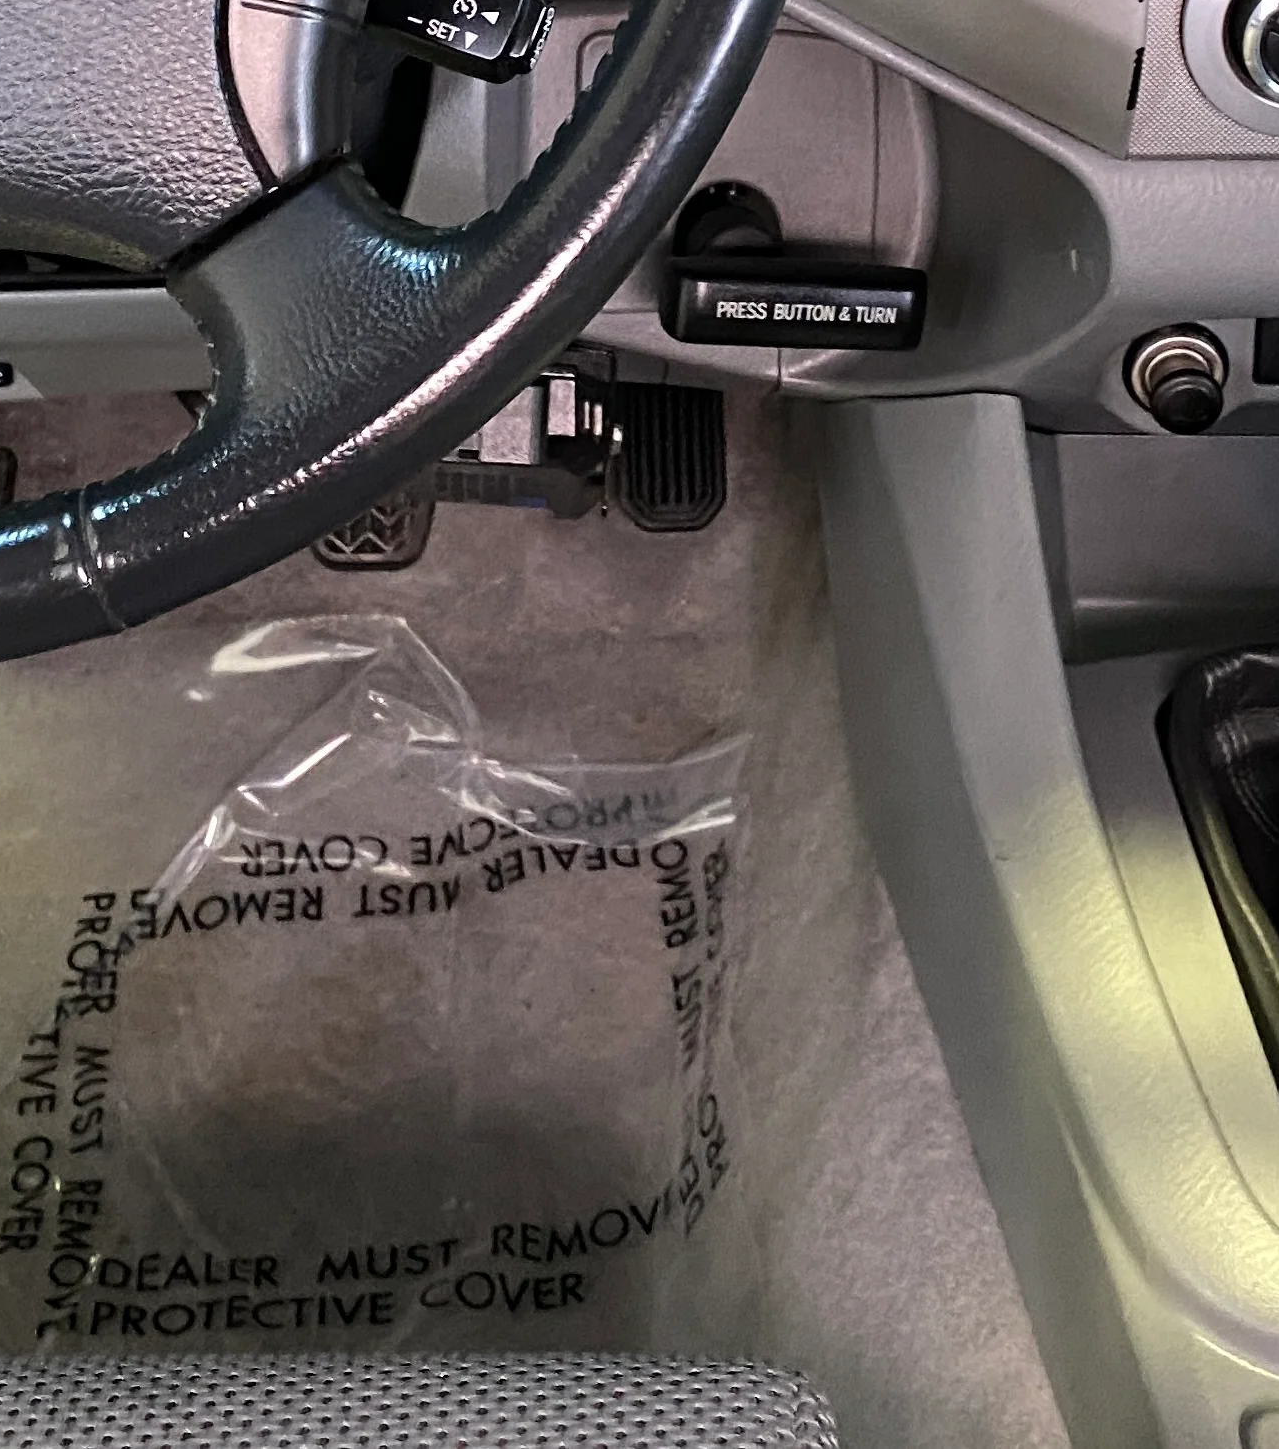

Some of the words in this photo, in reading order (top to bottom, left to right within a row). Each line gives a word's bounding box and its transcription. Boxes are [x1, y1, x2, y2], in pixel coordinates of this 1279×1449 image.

[426, 18, 461, 41] SET
[716, 301, 768, 320] PRESS
[773, 303, 835, 322] BUTTON
[838, 306, 851, 322] &
[855, 306, 898, 324] TURN
[69, 1045, 111, 1155] MUST
[98, 1252, 278, 1293] DEALER
[317, 1238, 459, 1284] MUST
[90, 1290, 395, 1337] PROTECTIVE
[420, 1270, 584, 1313] COVER
